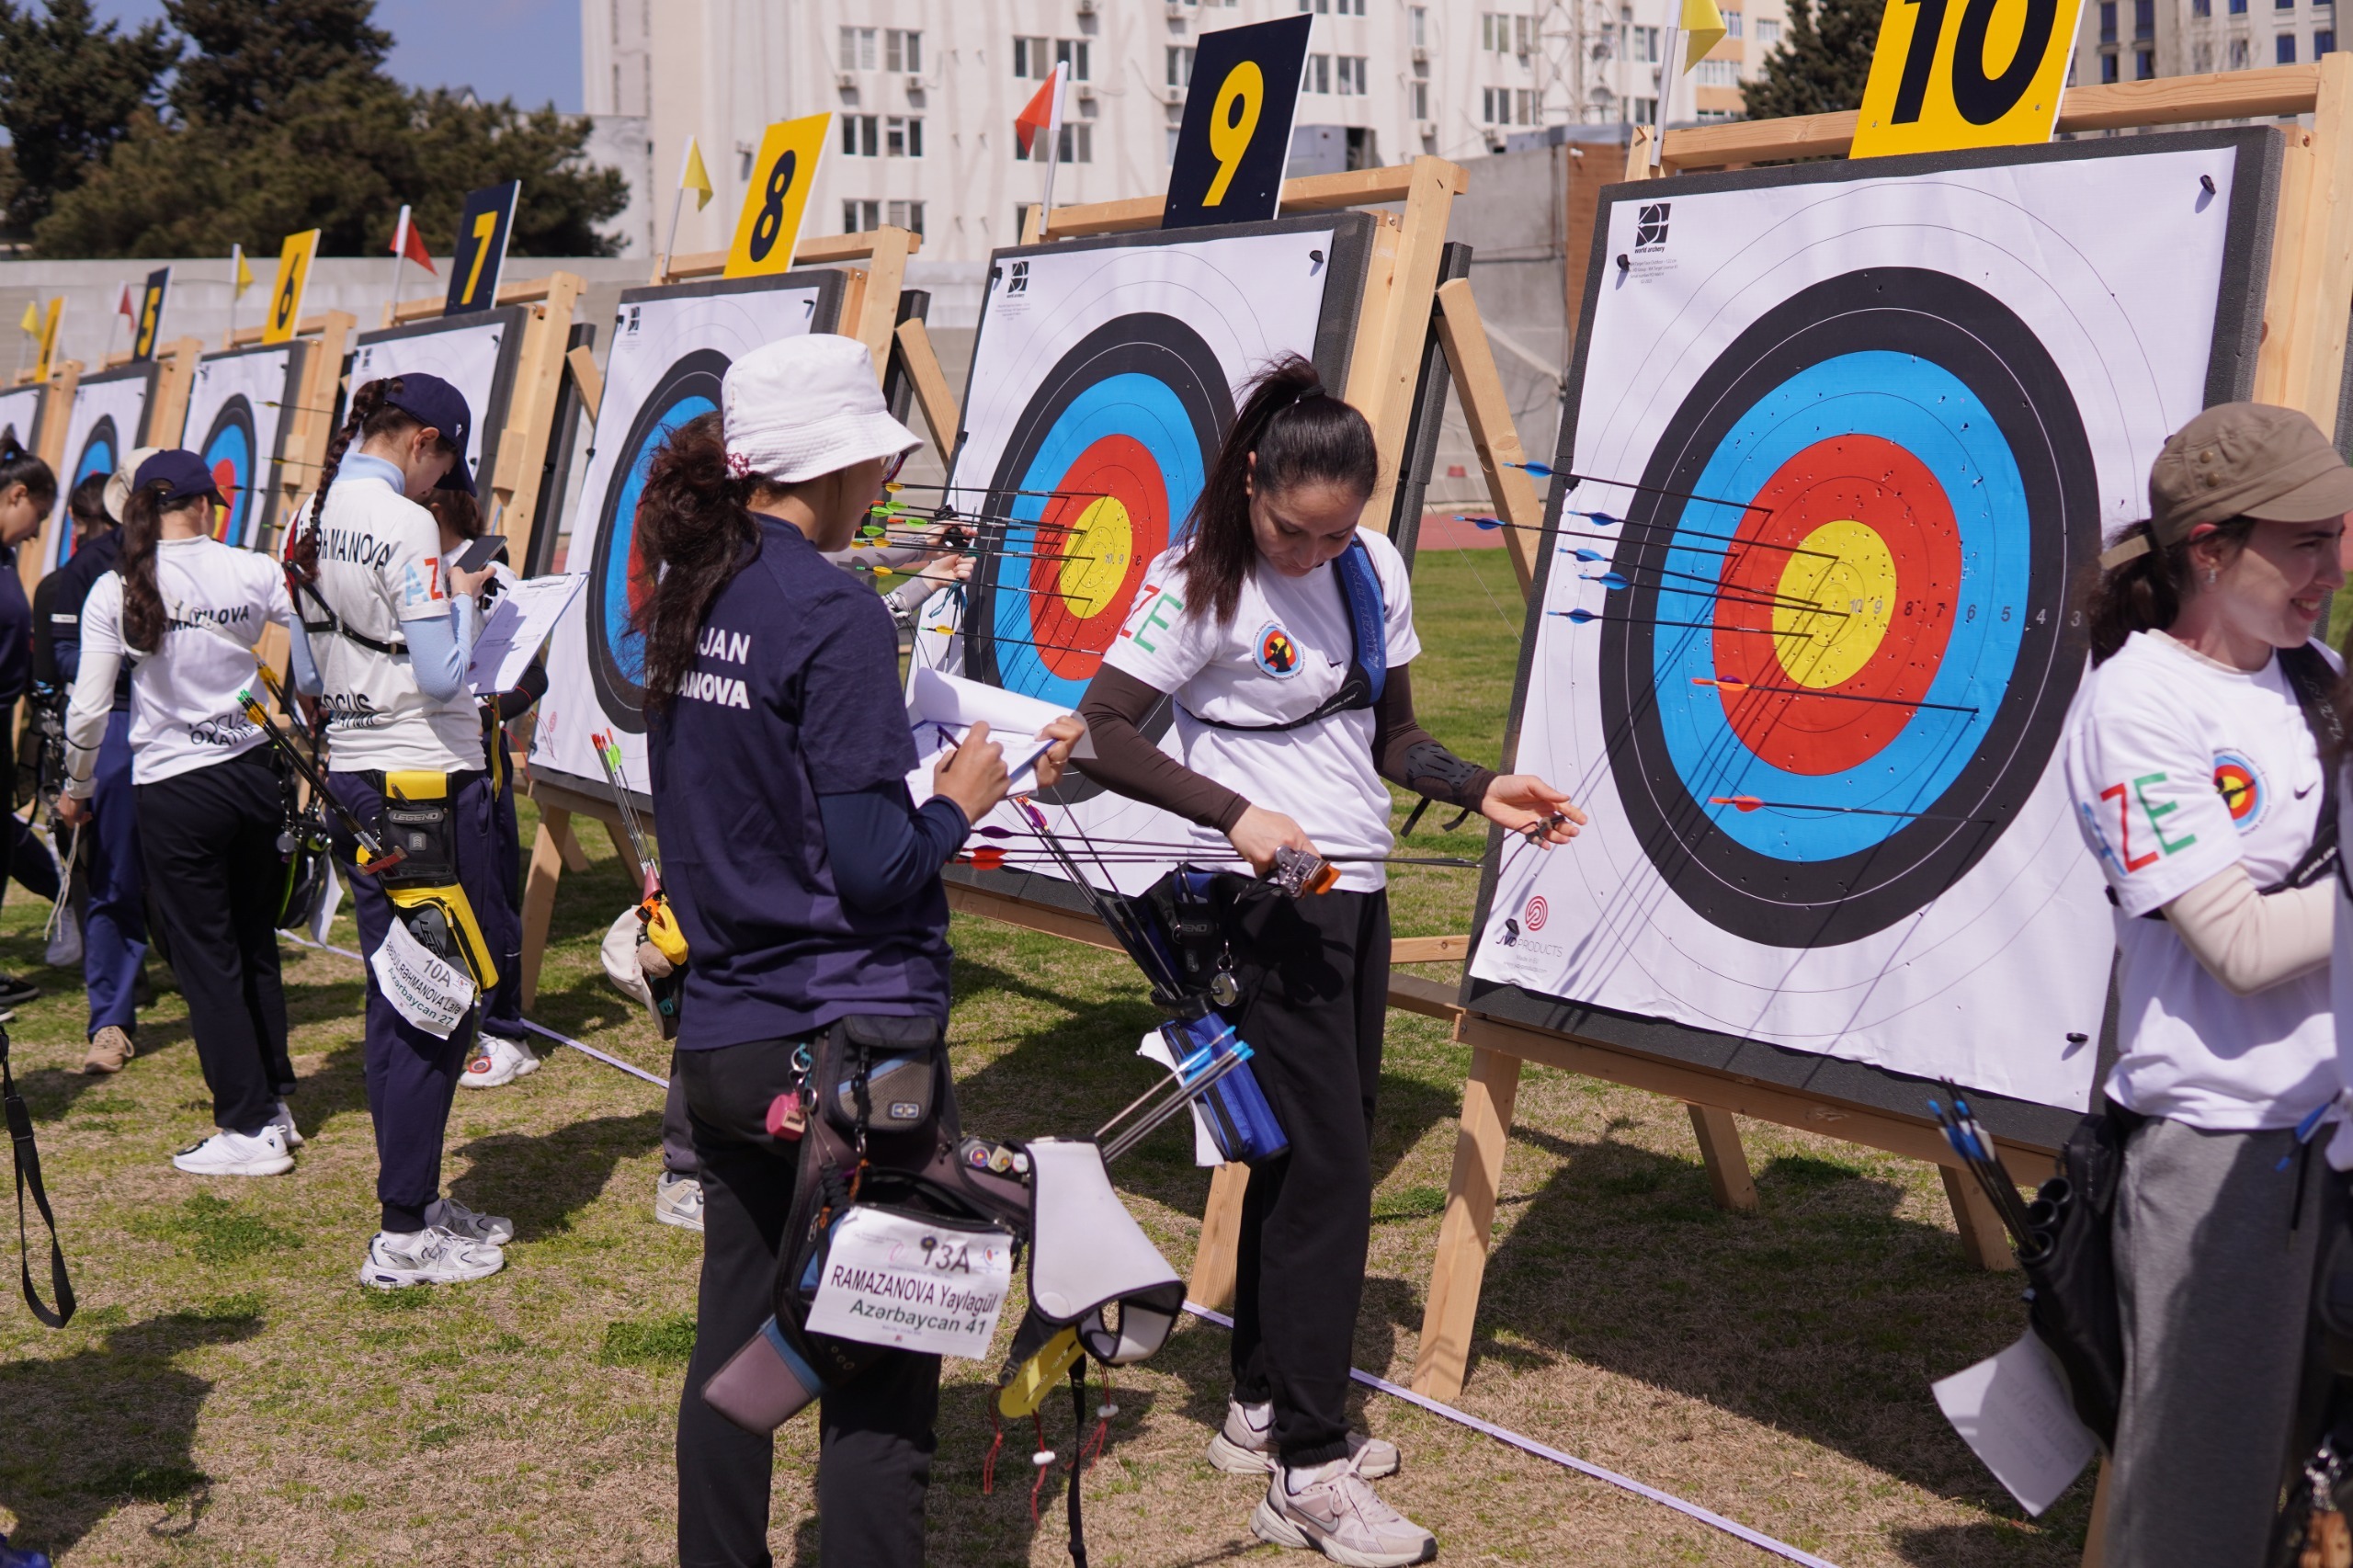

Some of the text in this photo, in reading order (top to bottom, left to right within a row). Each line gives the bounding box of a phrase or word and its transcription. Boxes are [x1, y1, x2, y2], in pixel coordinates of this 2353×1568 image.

[1891, 0, 2057, 125] 10
[1201, 61, 1264, 207] 9
[750, 150, 796, 262] 8
[460, 210, 498, 305] 7
[278, 253, 301, 330] 6
[138, 287, 162, 357] 5
[1119, 554, 1124, 564] 9
[1849, 598, 2082, 627] 10 9 8 7 6 5 4 3
[676, 671, 751, 710] ANOVA
[393, 812, 439, 822] LEGEND
[1495, 935, 1563, 957] JVD PRODUCTS
[388, 967, 437, 1019] Azərbaycan
[438, 1015, 454, 1026] 27
[424, 959, 451, 988] 10A
[830, 1266, 934, 1305] RAMAZANOVA
[939, 1286, 998, 1317] Yaylagül
[849, 1299, 960, 1332] Azərbaycan
[965, 1320, 987, 1335] 41
